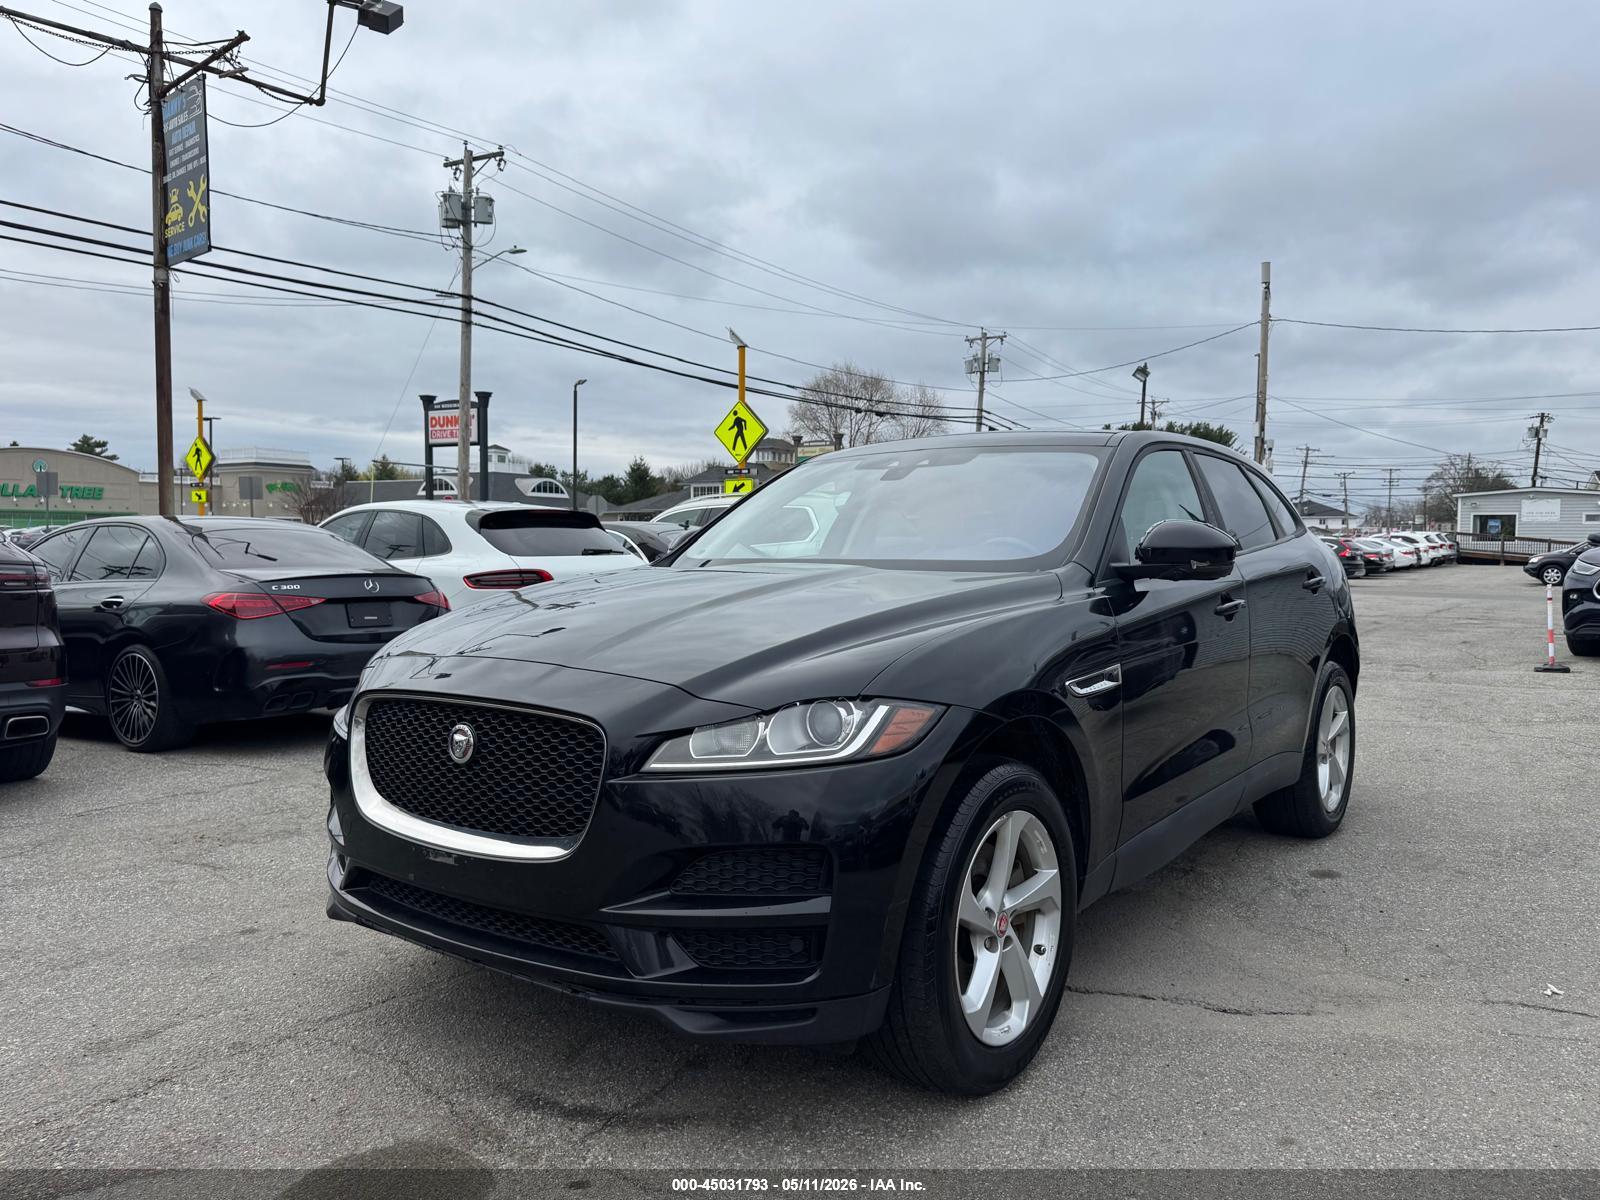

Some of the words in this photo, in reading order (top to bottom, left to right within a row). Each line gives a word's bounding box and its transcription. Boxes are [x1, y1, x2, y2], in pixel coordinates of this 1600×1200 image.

[165, 222, 185, 238] SERVICE
[0, 483, 40, 497] LLA
[60, 485, 104, 500] TREE
